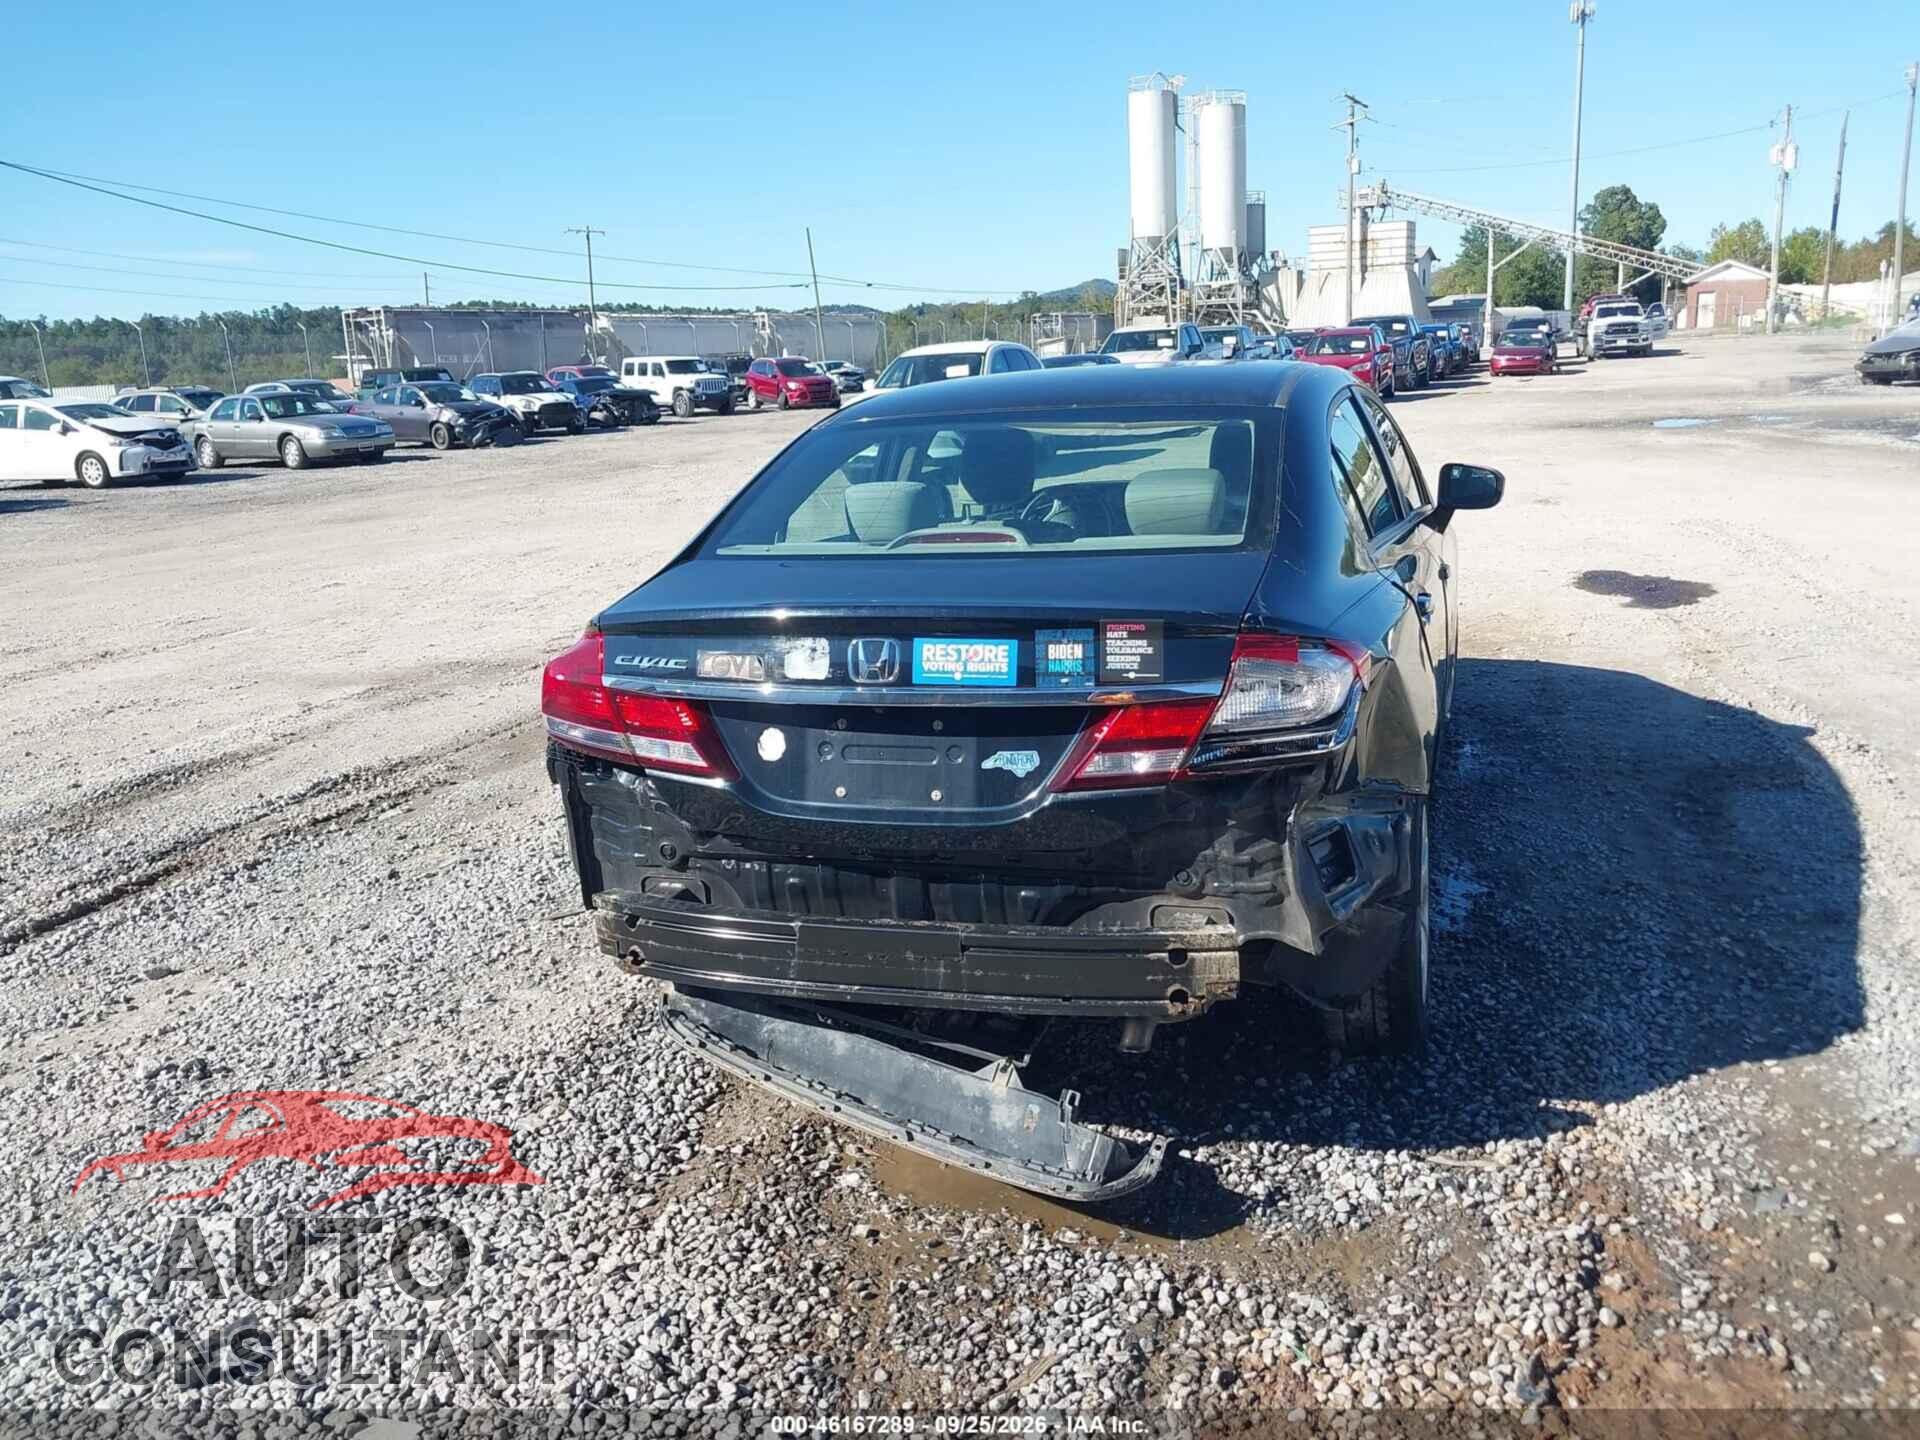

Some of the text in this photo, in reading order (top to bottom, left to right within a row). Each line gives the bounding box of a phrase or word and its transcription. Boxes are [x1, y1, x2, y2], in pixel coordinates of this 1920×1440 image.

[1106, 624, 1146, 632] FIGHTING
[1106, 639, 1148, 647] TEACHING
[922, 643, 1009, 662] RESTORE
[1048, 643, 1083, 659] BIDEN
[614, 655, 688, 669] CIVIC
[922, 661, 1009, 673] VOTING RIGHTS
[1048, 659, 1083, 672] HARRIS
